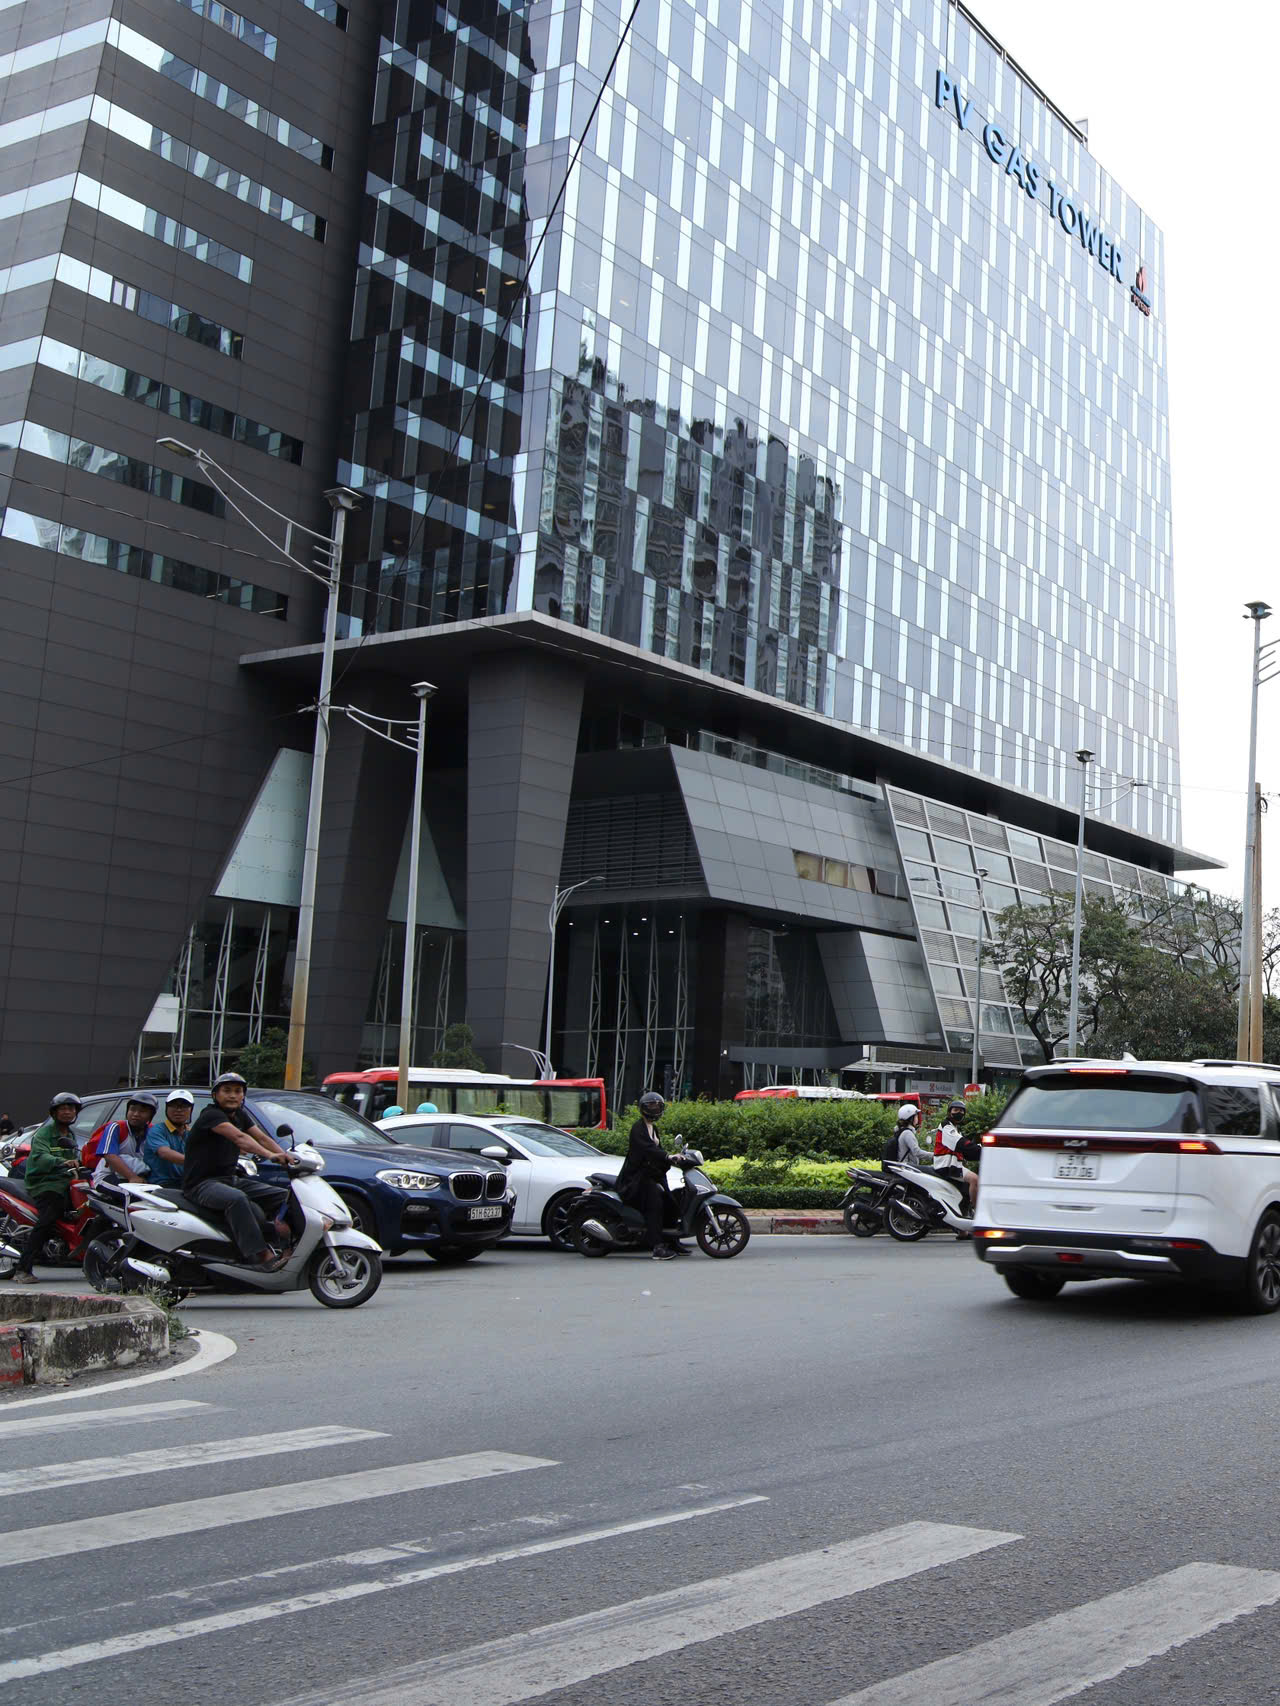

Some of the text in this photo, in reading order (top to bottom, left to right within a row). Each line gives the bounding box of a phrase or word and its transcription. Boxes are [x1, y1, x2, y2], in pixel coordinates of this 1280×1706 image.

[935, 69, 1124, 283] PV GAS TOWER
